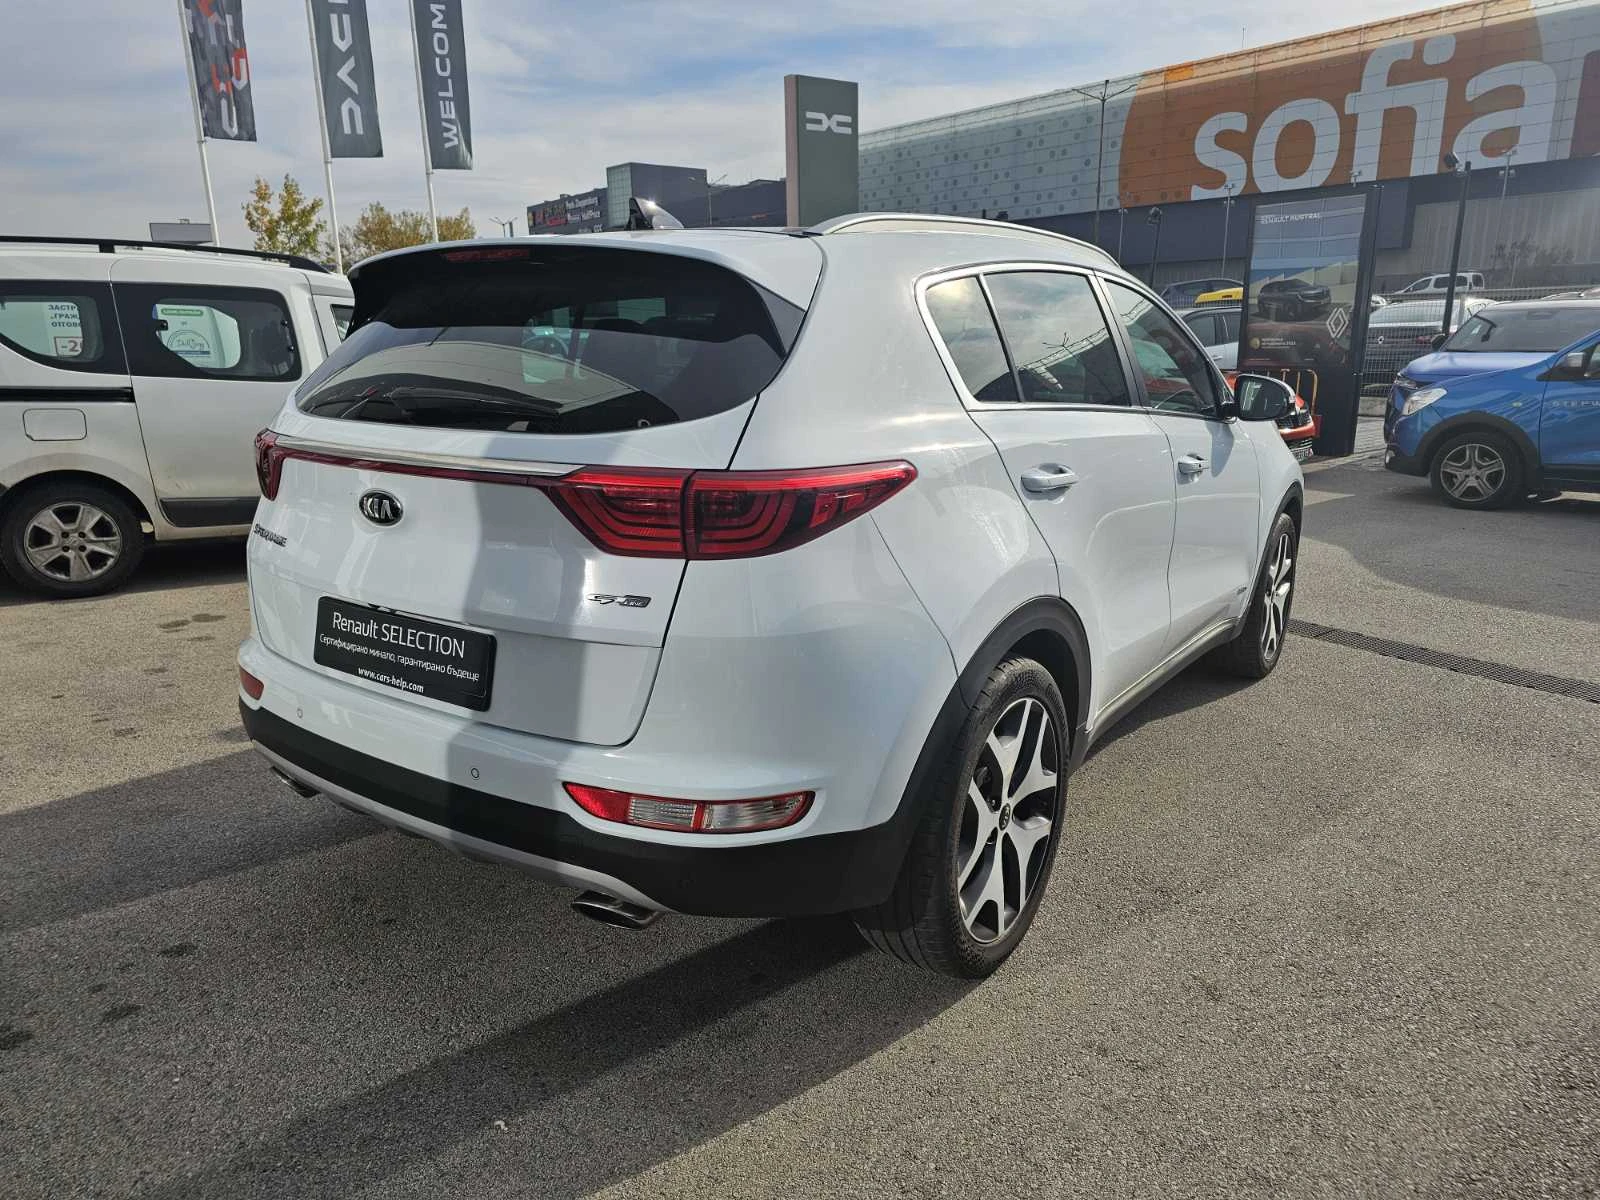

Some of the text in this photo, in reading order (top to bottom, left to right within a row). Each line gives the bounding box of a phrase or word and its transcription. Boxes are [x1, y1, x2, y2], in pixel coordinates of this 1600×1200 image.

[429, 4, 459, 149] WELCOM
[1191, 34, 1557, 201] sofia
[61, 340, 82, 352] -2
[363, 496, 394, 520] KIA
[319, 633, 369, 655] Сертифицирано
[397, 655, 446, 673] гарантирано
[447, 664, 480, 682] бъдеще
[332, 611, 465, 659] Renault SELECTION
[358, 667, 424, 693] www.cars-help.com
